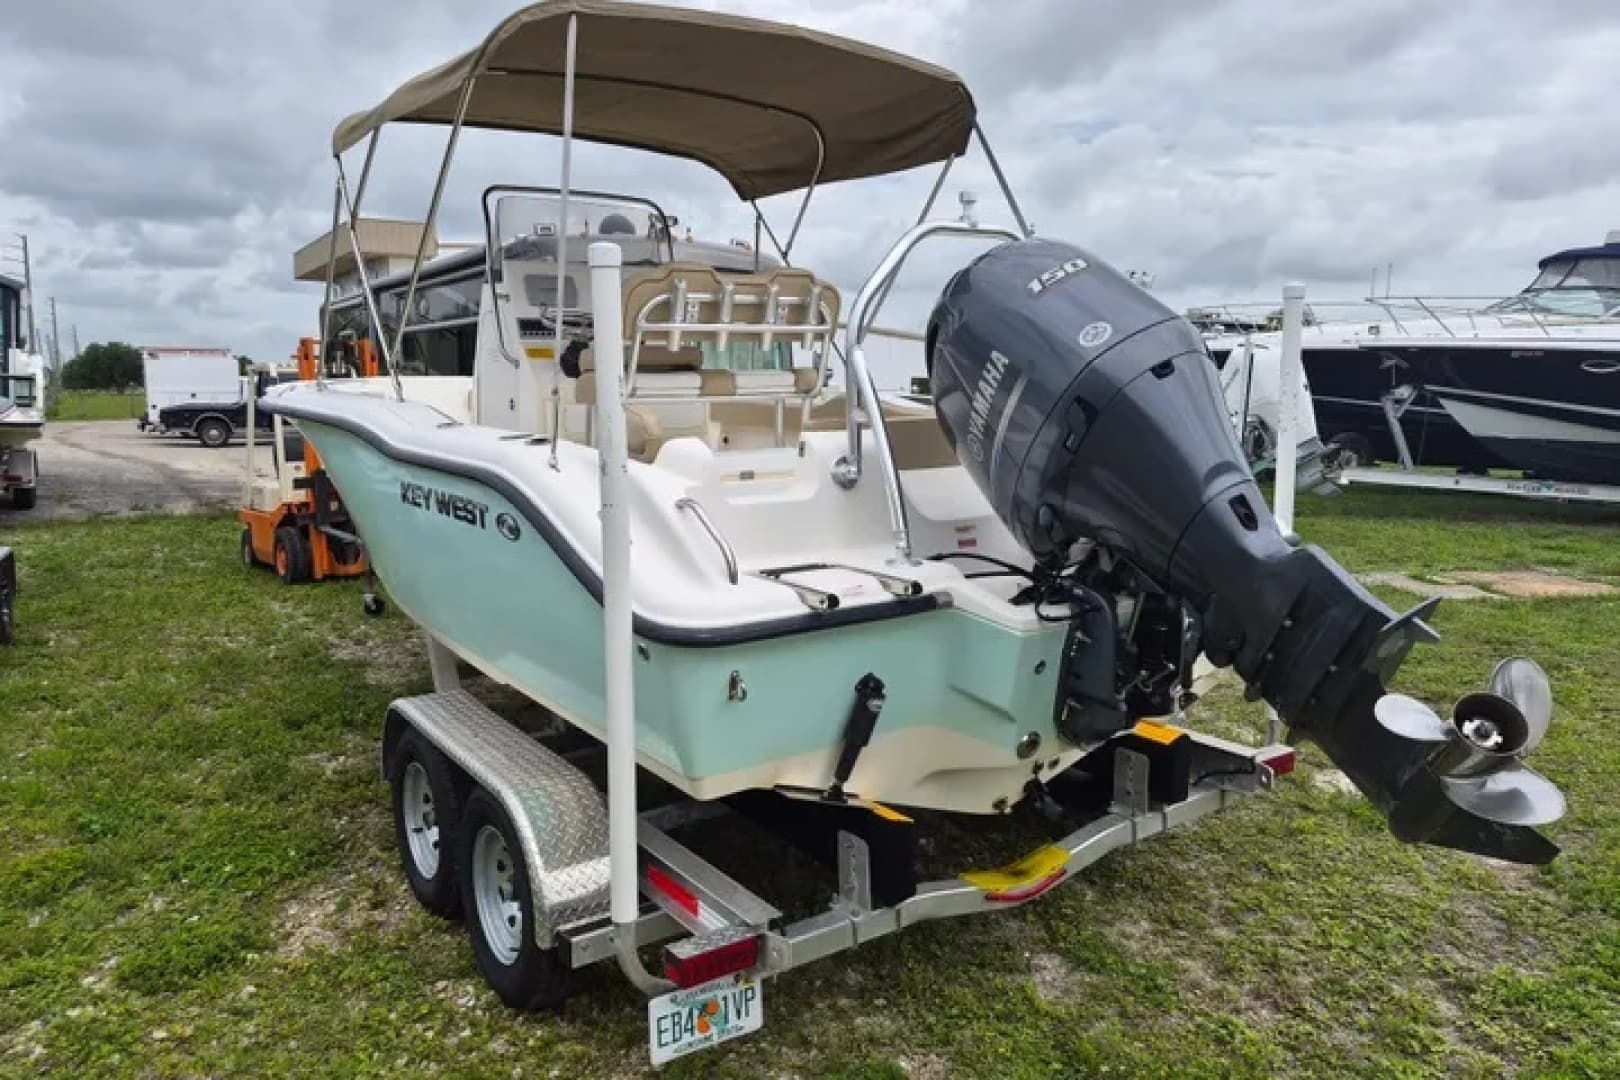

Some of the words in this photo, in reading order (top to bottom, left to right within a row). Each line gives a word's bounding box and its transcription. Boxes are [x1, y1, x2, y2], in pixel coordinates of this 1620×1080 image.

[1027, 258, 1088, 294] 150
[968, 350, 1009, 441] YAMAHA
[400, 480, 433, 511] KEY
[434, 489, 488, 530] WEST
